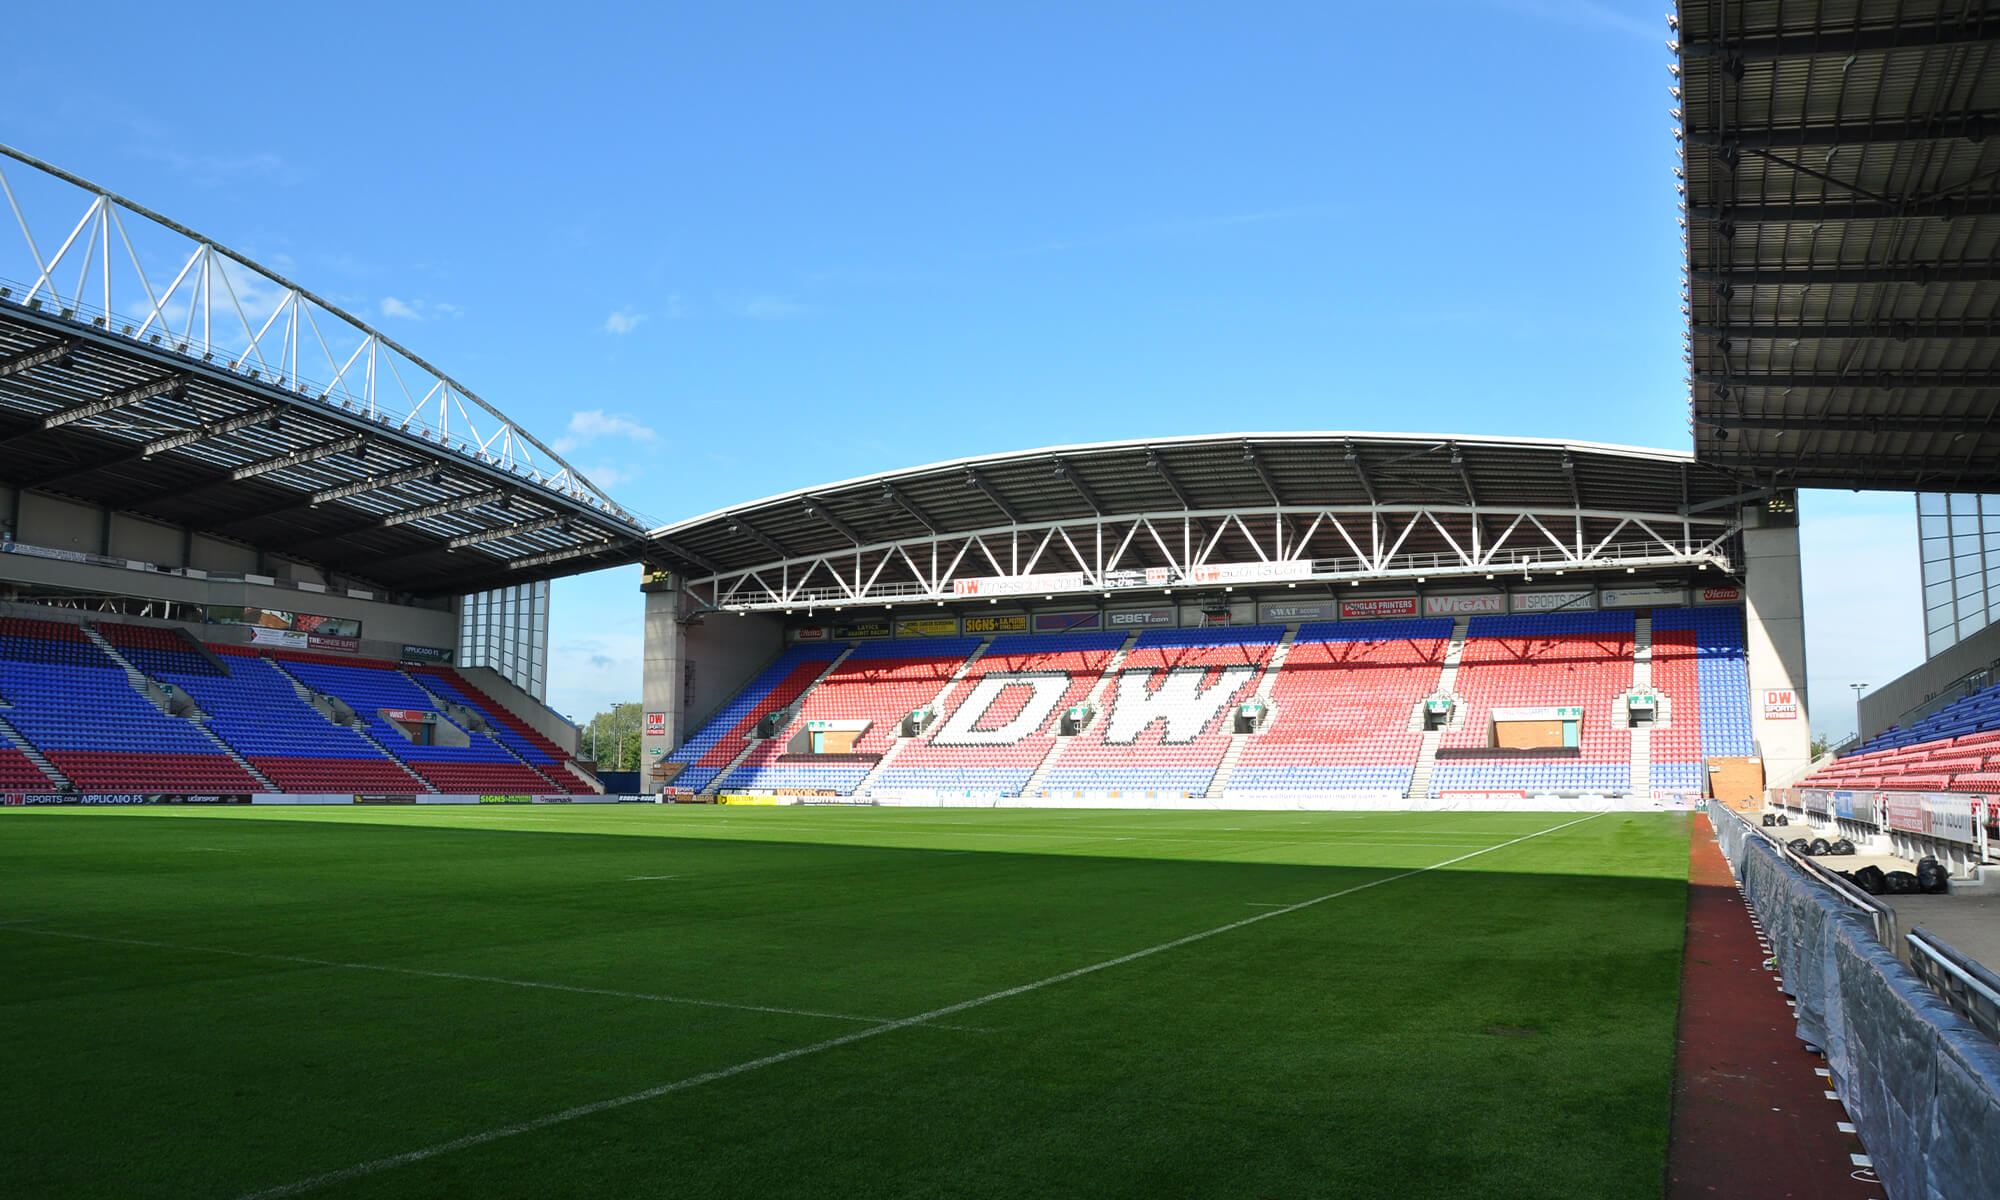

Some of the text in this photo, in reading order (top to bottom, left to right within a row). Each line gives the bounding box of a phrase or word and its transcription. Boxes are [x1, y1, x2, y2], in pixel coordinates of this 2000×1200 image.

[1345, 600, 1413, 612] DOUGLAS PRINTERS
[1428, 597, 1500, 613] WIGAN
[966, 618, 996, 632] SIGNS
[1768, 691, 1792, 704] DW
[926, 664, 1262, 748] DW
[649, 714, 663, 724] DW
[5, 794, 25, 805] DW
[480, 795, 506, 803] SIGNS
